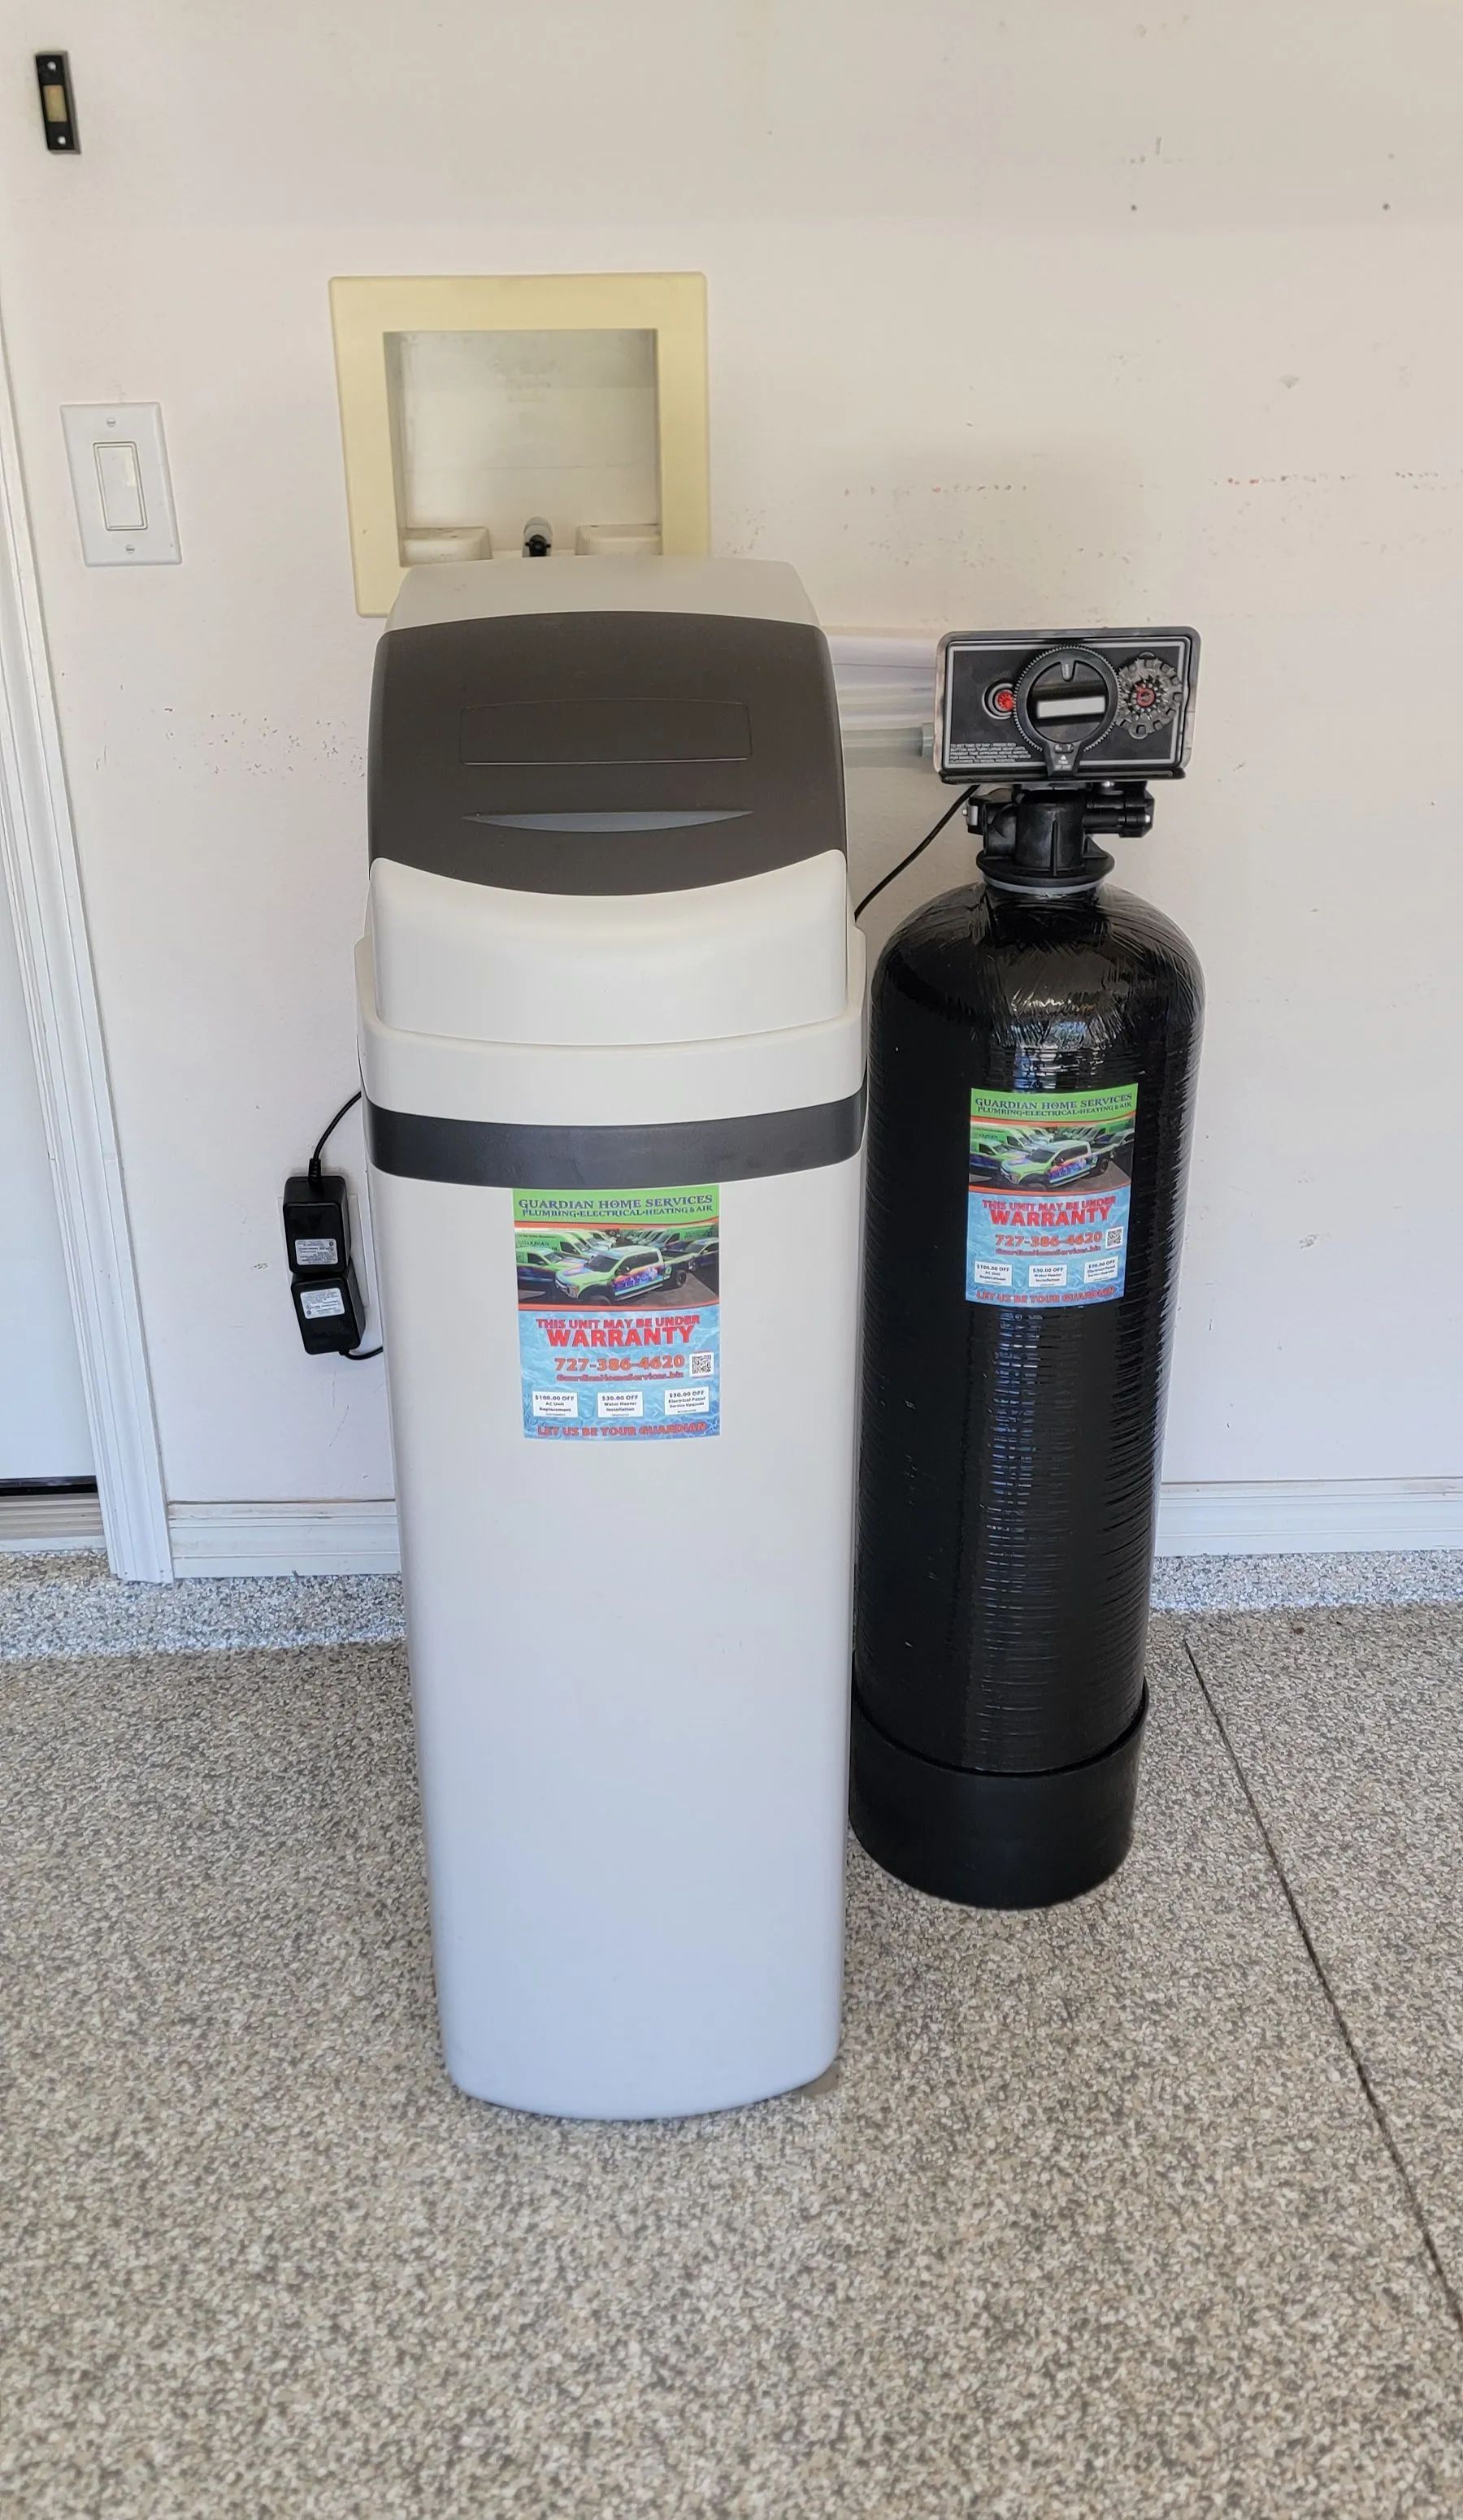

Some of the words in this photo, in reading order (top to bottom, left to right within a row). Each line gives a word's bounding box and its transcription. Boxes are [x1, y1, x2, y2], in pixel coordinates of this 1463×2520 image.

[975, 1097, 1037, 1109] GUARDIAN
[1042, 1100, 1078, 1110] HOME
[1080, 1094, 1132, 1108] SERVICES
[519, 1199, 594, 1211] GUARDIAN
[598, 1198, 641, 1210] HOME
[645, 1195, 713, 1208] SERVICES
[697, 1204, 714, 1212] AIR
[982, 1199, 1007, 1210] THIS
[1009, 1202, 1036, 1212] UNIT
[1038, 1202, 1064, 1211] MAY
[1066, 1200, 1080, 1210] BE
[1081, 1196, 1117, 1208] UNDER
[990, 1204, 1111, 1227] WARRANTY
[995, 1230, 1103, 1247] 727-386-4620
[1030, 1294, 1060, 1303] YOUR
[536, 1319, 566, 1329] THIS
[569, 1319, 601, 1329] UNIT
[603, 1319, 633, 1329] MAY
[636, 1318, 653, 1328] BE
[655, 1315, 701, 1325] UNDER
[546, 1325, 695, 1347] WARRANTY
[554, 1355, 685, 1372] 727-386-4620
[537, 1425, 559, 1437] LET
[562, 1426, 580, 1436] US
[582, 1426, 598, 1437] BE
[601, 1426, 637, 1437] YOUR
[639, 1421, 707, 1435] GUARDIAN
